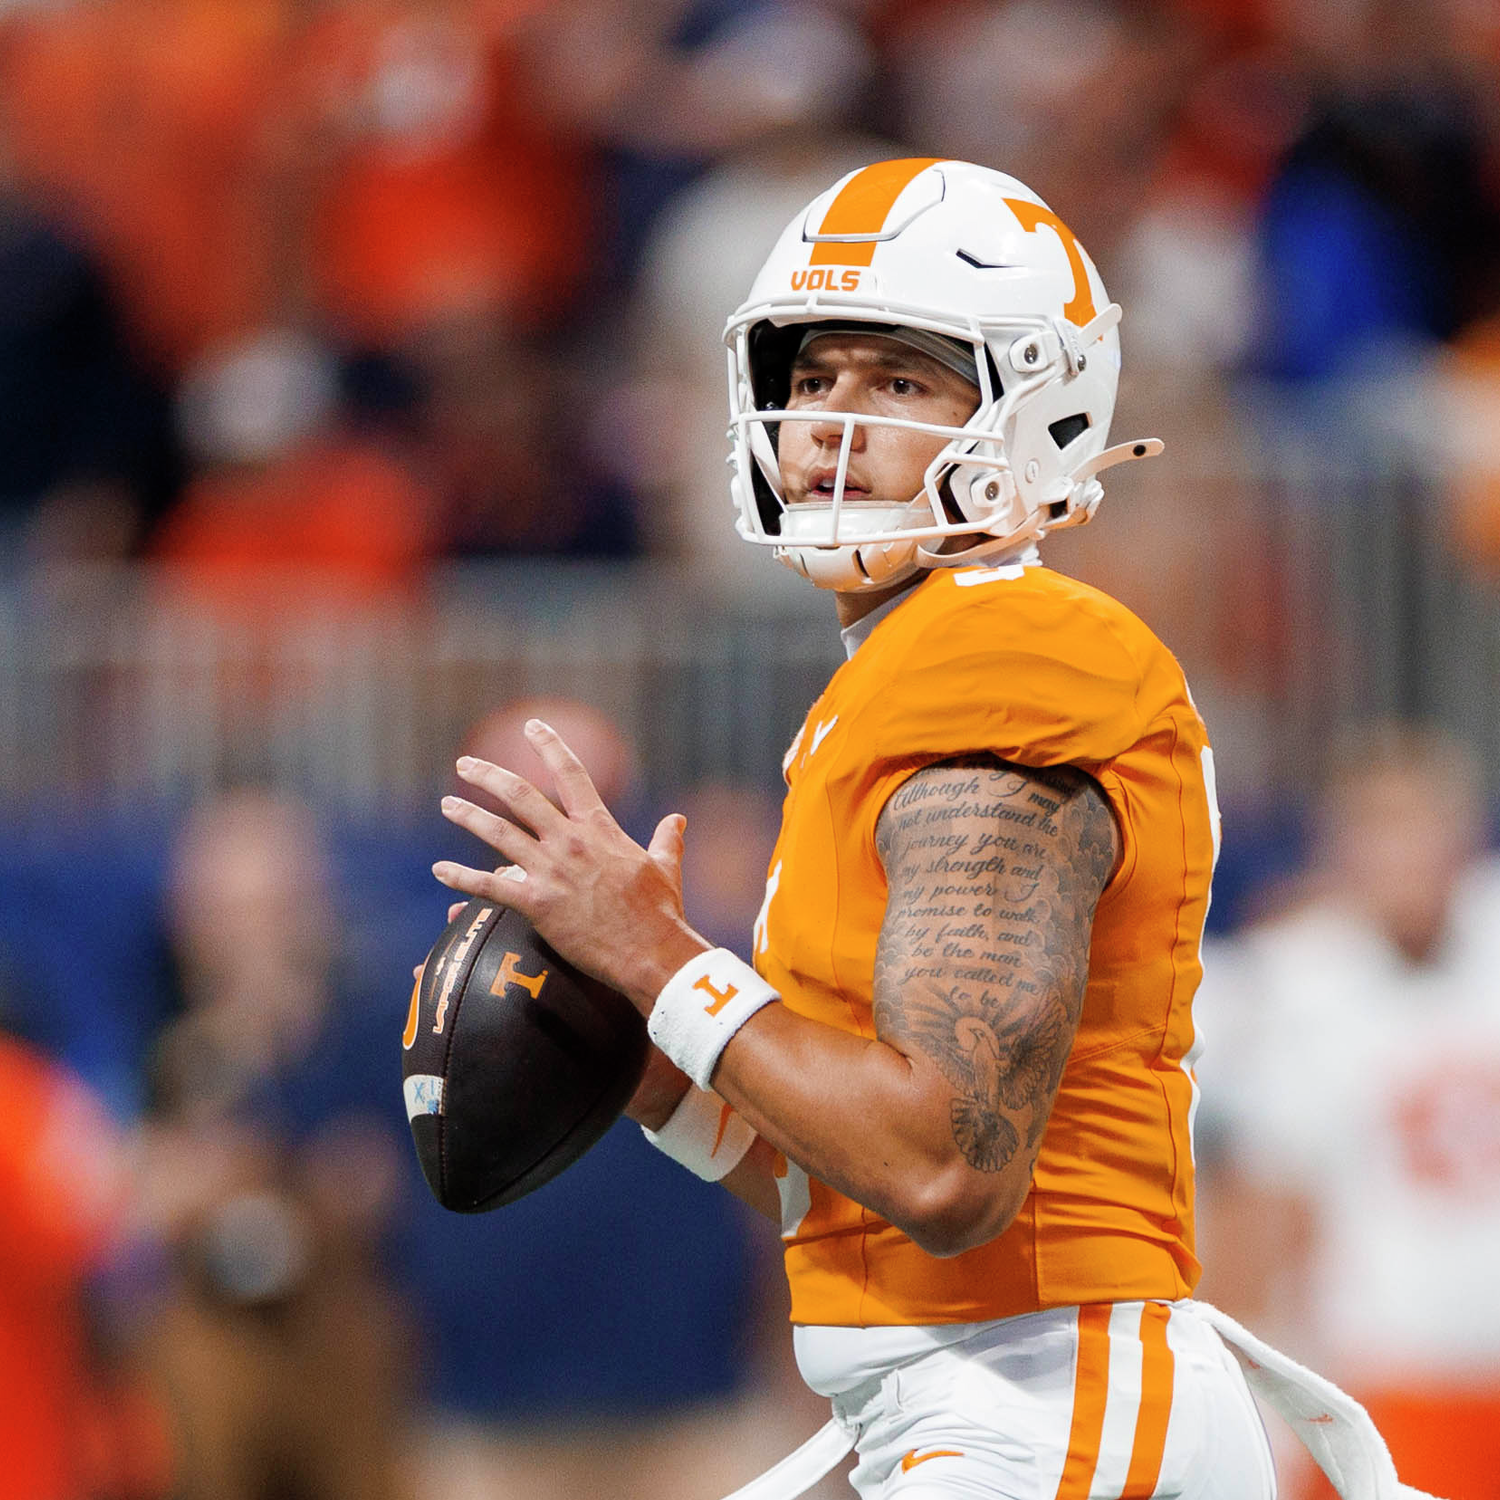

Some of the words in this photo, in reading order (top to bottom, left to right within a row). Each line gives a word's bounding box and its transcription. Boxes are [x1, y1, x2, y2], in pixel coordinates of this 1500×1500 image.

[790, 269, 861, 292] VOLS
[894, 776, 980, 810] Although
[925, 801, 1037, 827] understand
[1038, 817, 1058, 837] the
[902, 833, 969, 860] journey
[970, 833, 1018, 855] you
[926, 856, 1007, 880] strength
[1010, 864, 1044, 881] and
[930, 883, 997, 901] power
[973, 903, 993, 918] to
[904, 924, 930, 944] by
[998, 930, 1034, 947] and
[911, 944, 934, 957] be
[942, 942, 975, 958] the
[433, 961, 463, 1034] VAPOR
[454, 908, 494, 962] ELITE
[490, 952, 549, 1000] T
[899, 966, 946, 986] you
[953, 968, 1014, 988] called
[692, 974, 739, 1017] T
[949, 985, 972, 1001] to
